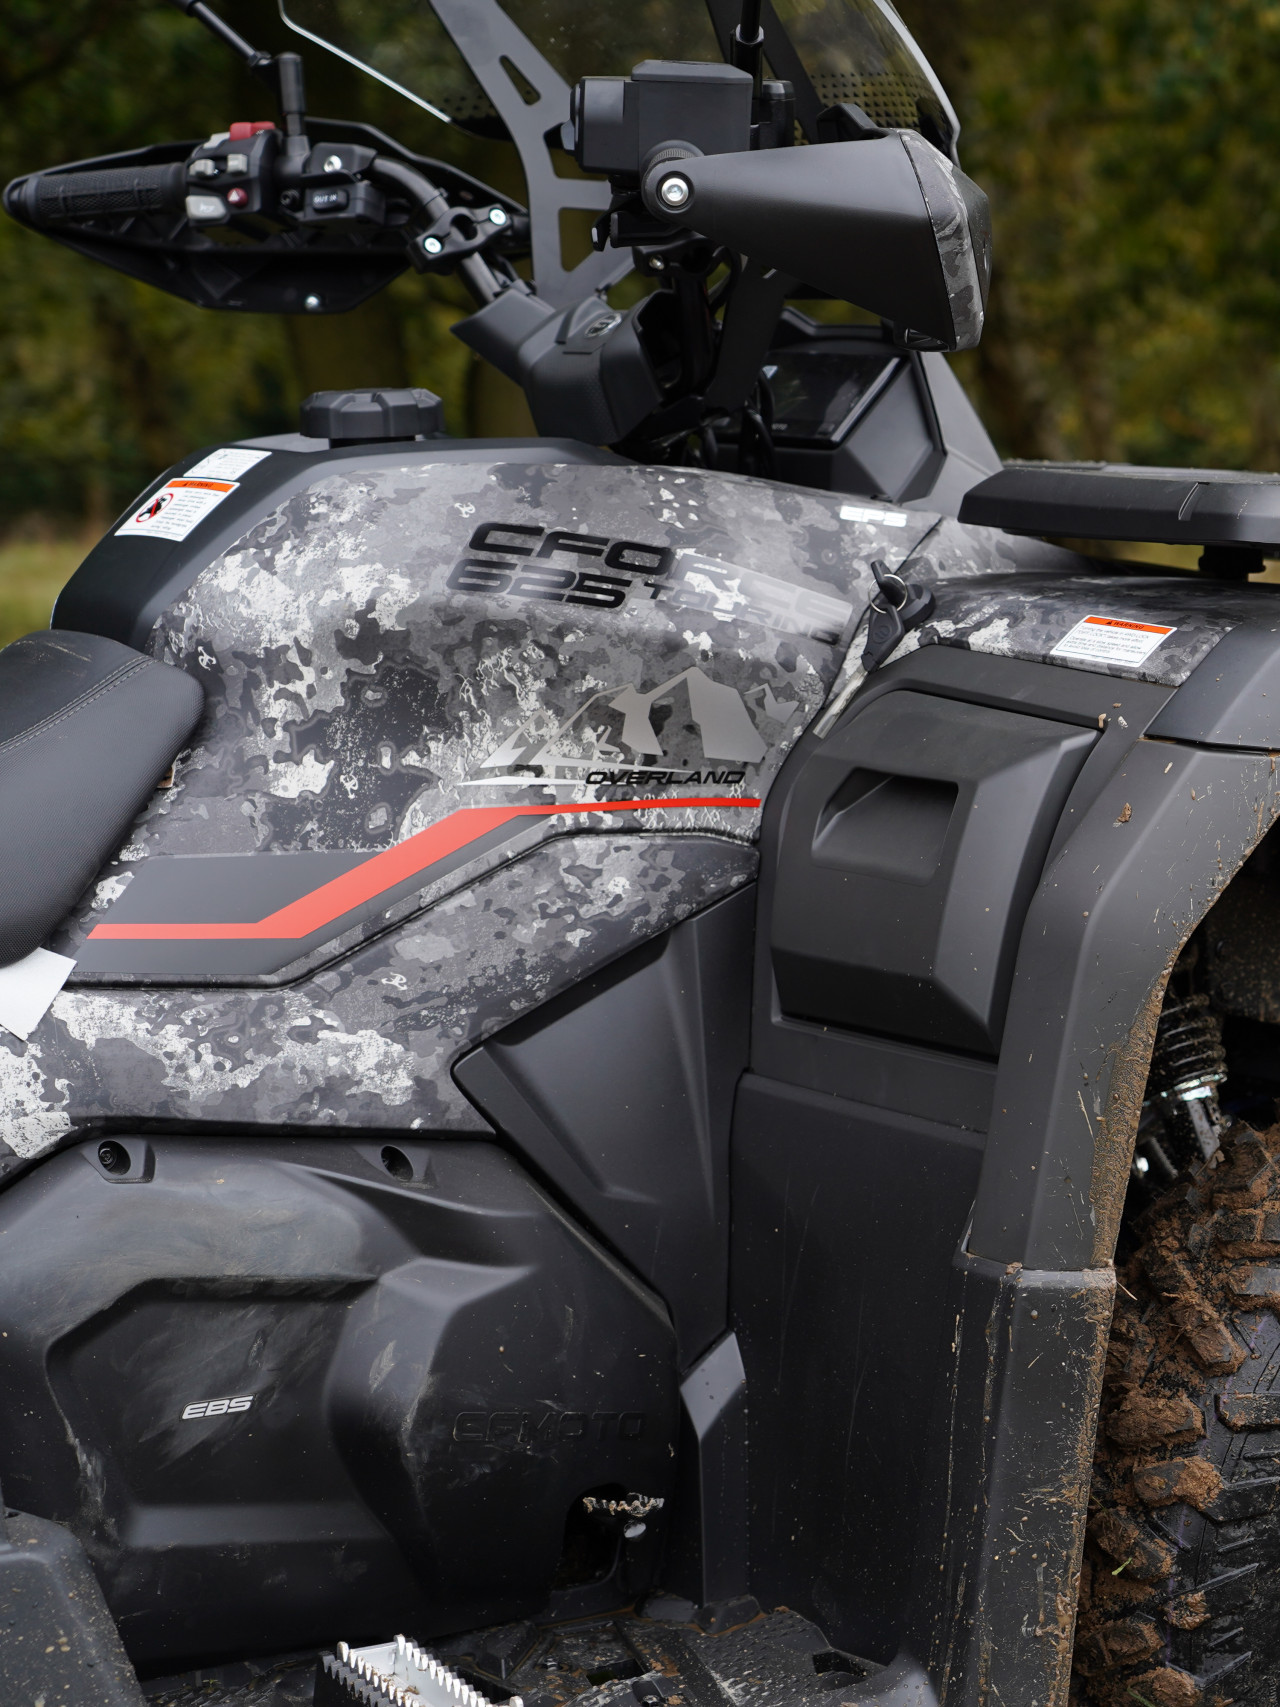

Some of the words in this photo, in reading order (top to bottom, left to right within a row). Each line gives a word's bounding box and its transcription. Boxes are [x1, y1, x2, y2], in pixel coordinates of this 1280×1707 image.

[839, 505, 907, 528] EPS
[446, 558, 628, 609] 625
[1113, 621, 1145, 630] WARNING
[585, 771, 746, 786] OVERLAND
[182, 1395, 255, 1420] EBS
